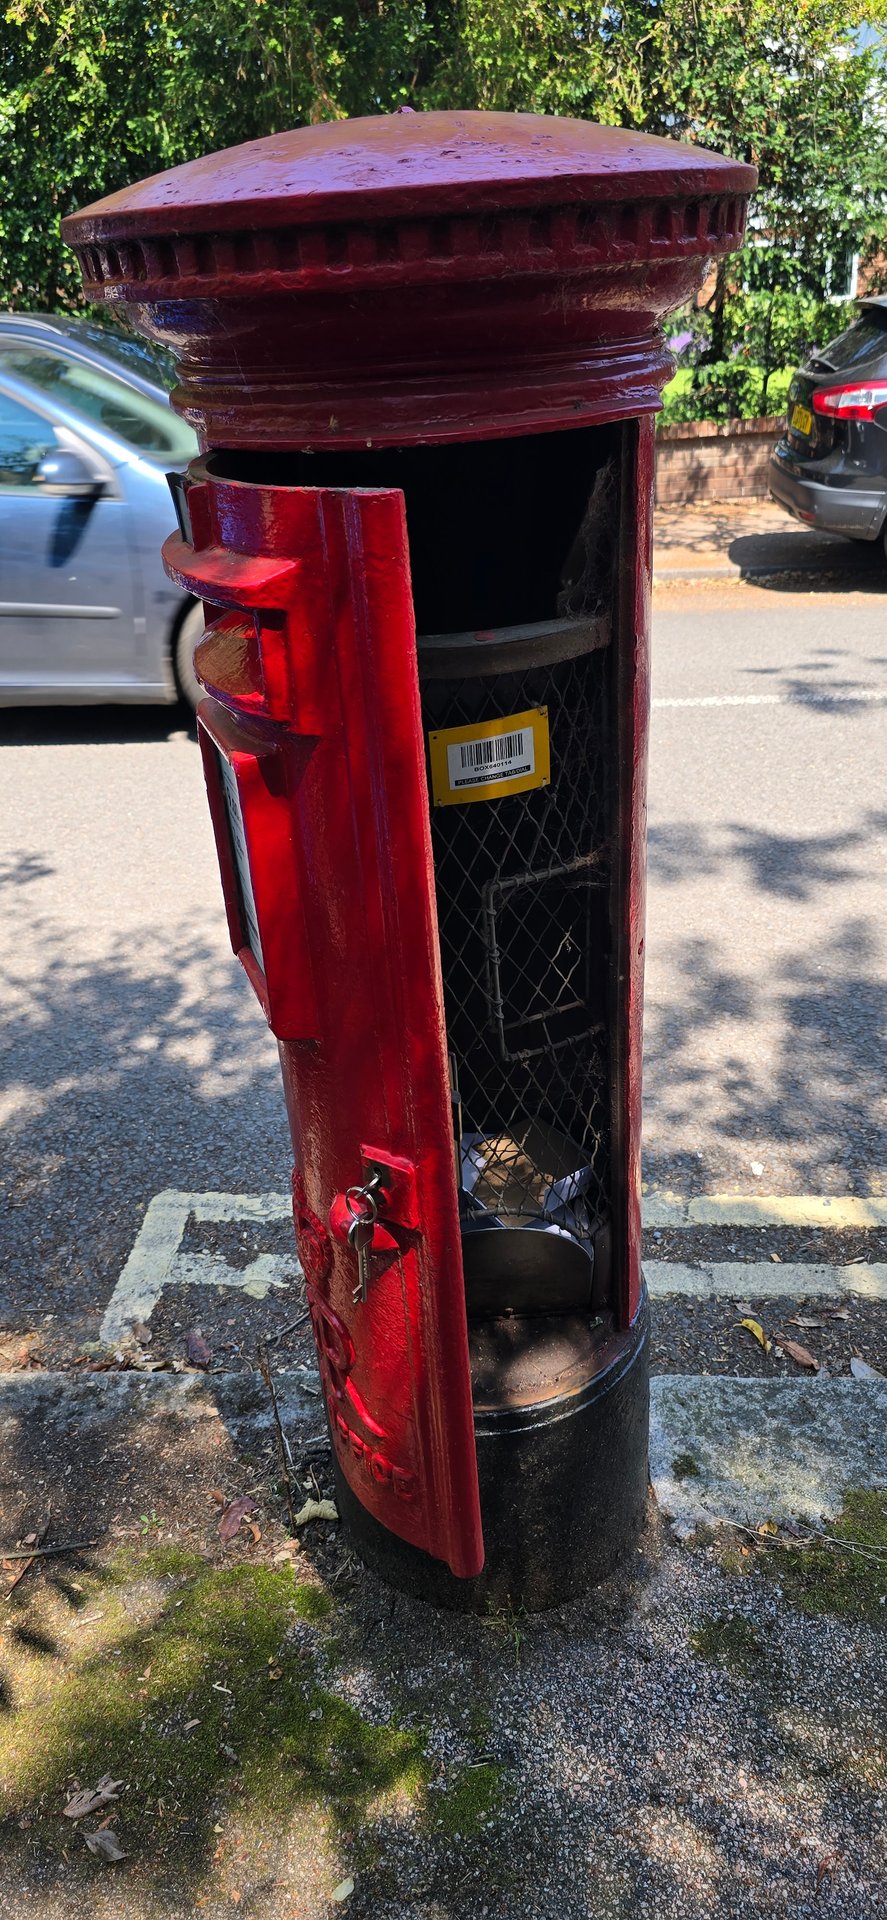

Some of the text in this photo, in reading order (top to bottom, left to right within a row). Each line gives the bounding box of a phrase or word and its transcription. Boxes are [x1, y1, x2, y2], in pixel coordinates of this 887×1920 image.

[474, 760, 512, 772] BOX640114
[457, 777, 479, 785] PLEASE
[480, 773, 503, 782] CHANGE
